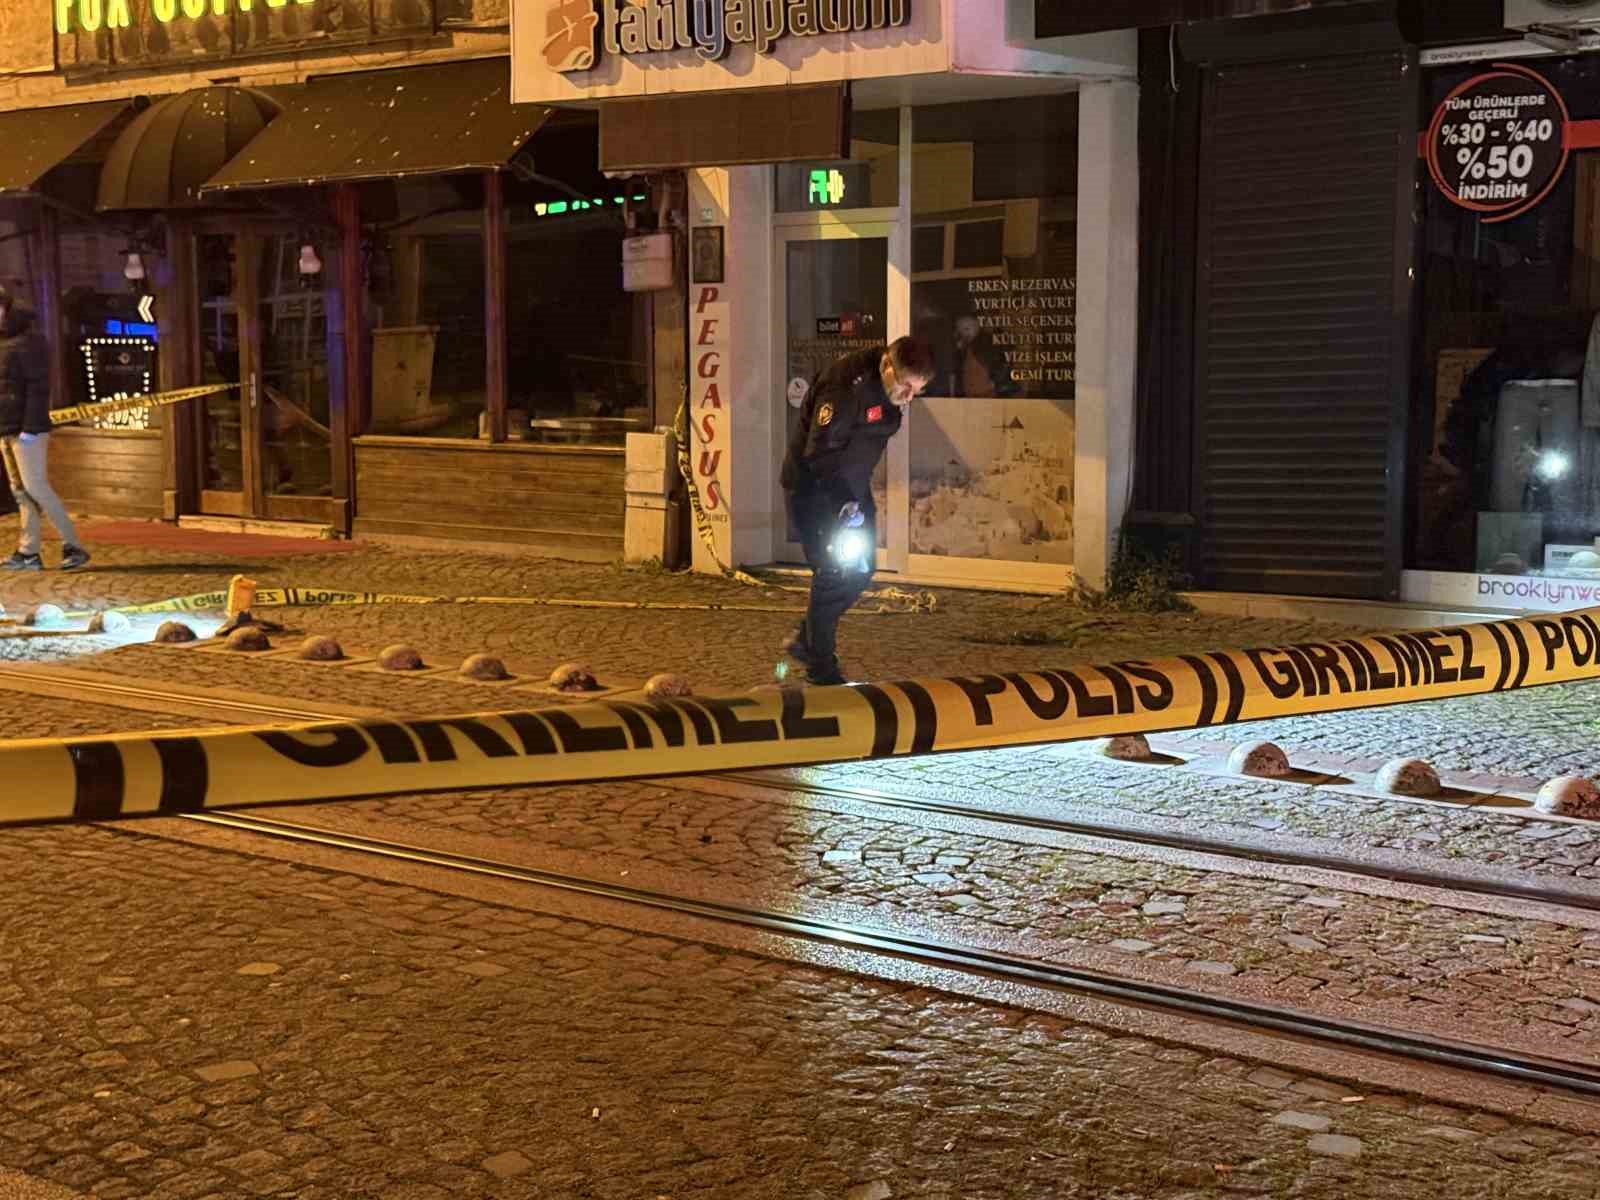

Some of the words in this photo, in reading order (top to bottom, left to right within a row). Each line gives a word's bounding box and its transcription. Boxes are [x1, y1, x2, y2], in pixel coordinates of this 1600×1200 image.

[1445, 97, 1471, 110] TÜM
[1473, 94, 1546, 109] ÜRÜNLERDE
[1468, 107, 1518, 122] GEÇERLİ
[1441, 122, 1486, 145] %30
[1506, 118, 1553, 142] %40
[1456, 143, 1534, 180] %50
[1458, 180, 1528, 199] İNDİRİM
[968, 280, 1009, 292] ERKEN
[696, 287, 721, 511] PEGASUS
